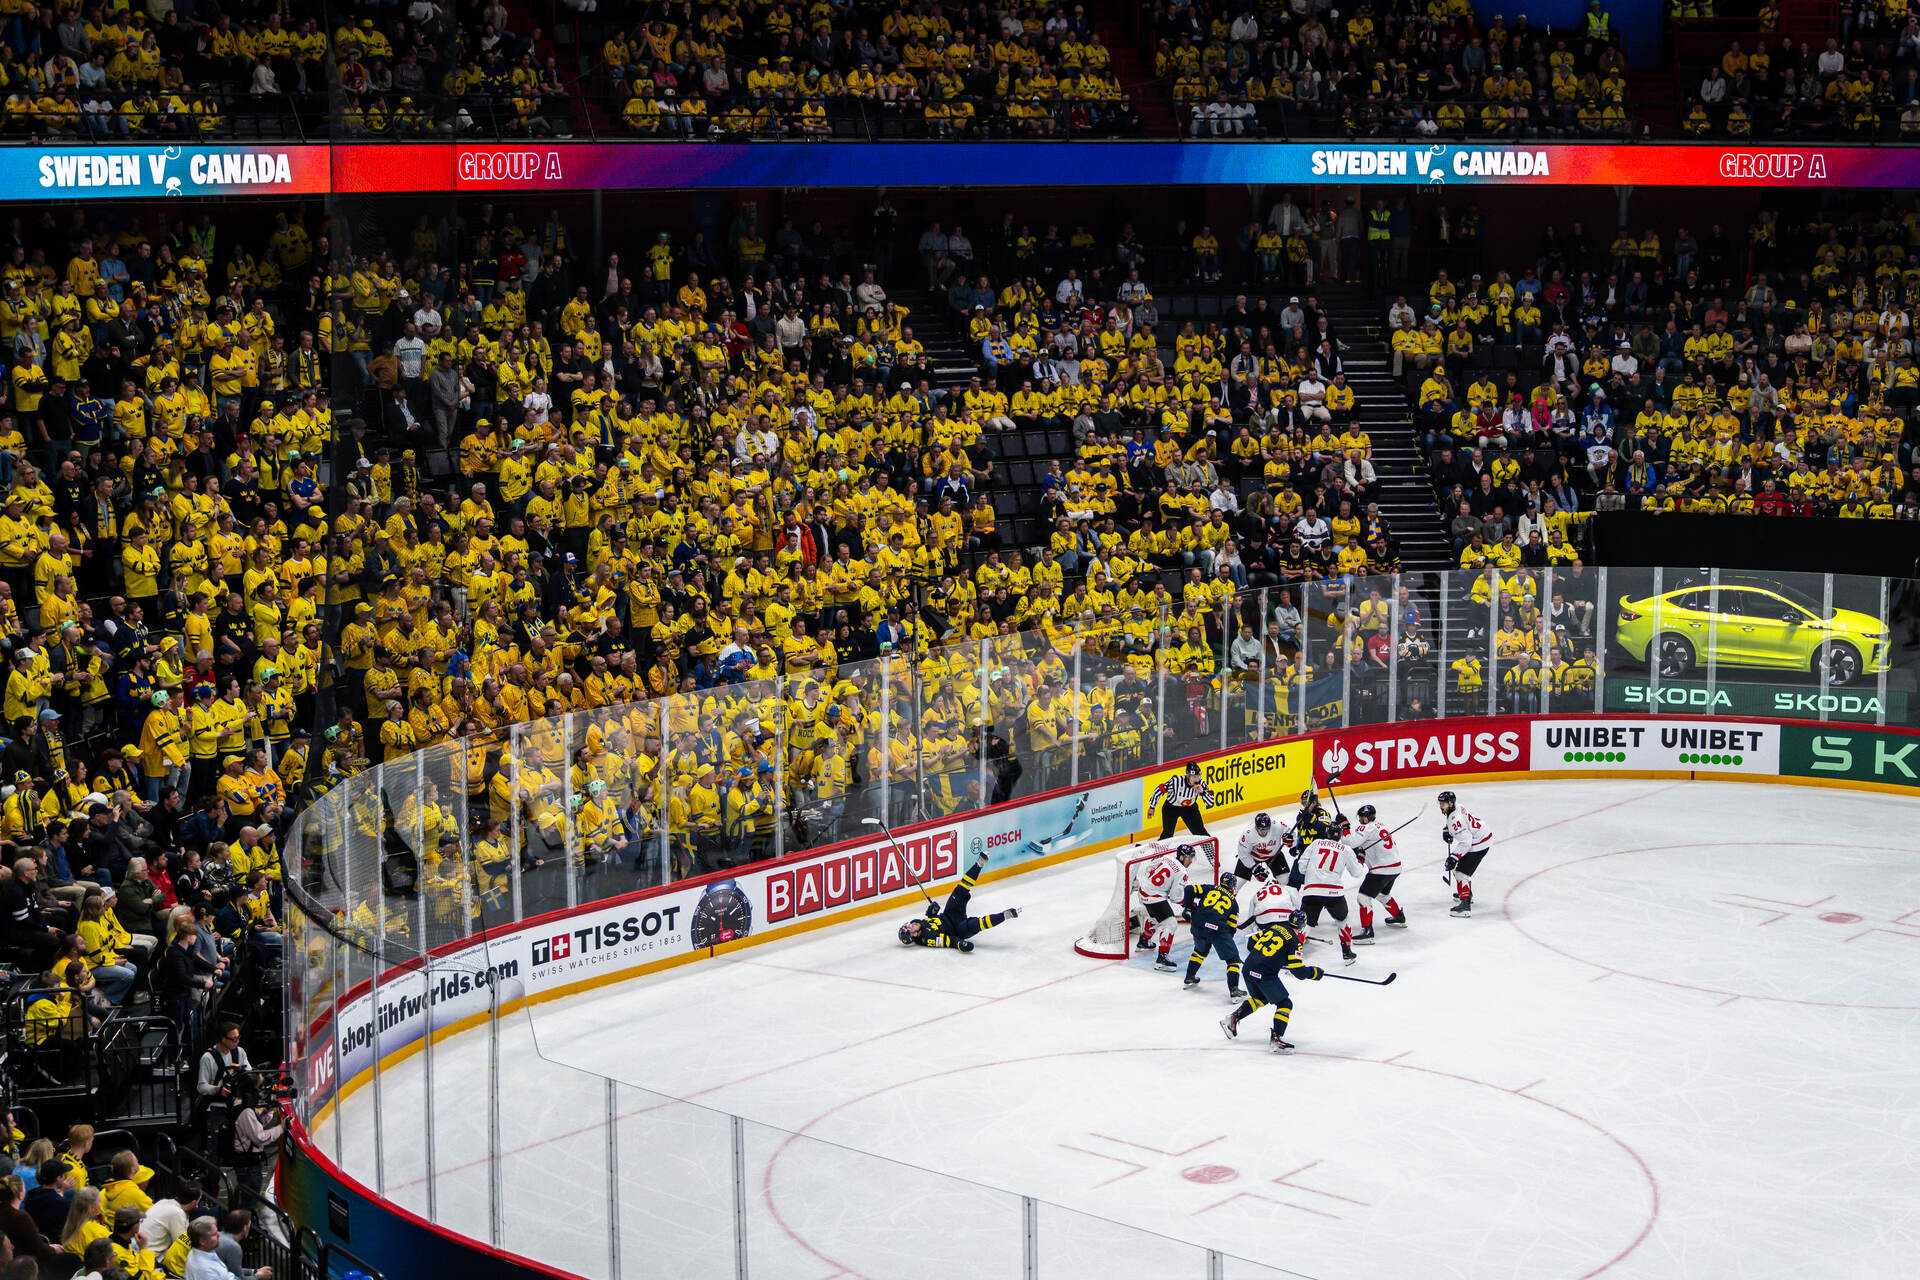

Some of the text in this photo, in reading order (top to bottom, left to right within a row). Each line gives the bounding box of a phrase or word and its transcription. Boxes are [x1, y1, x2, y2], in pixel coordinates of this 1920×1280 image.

[39, 154, 141, 187] SWEDEN
[189, 153, 292, 185] CANADA
[458, 152, 563, 181] GROUP A
[1311, 151, 1406, 176] SWEDEN
[1452, 151, 1550, 177] CANADA
[1719, 153, 1827, 179] GROUP A
[1250, 702, 1339, 728] LENHDA
[1546, 727, 1645, 748] UNIBET
[1660, 728, 1764, 752] UNIBET
[1354, 731, 1520, 773] STRAUSS
[1205, 752, 1286, 785] Raiffeisen
[1091, 802, 1118, 815] Unlimited
[1091, 807, 1138, 825] ProHygienic Aqua
[987, 828, 1022, 849] BOSCH
[1379, 829, 1396, 850] 9
[1318, 848, 1339, 872] 71
[769, 833, 956, 916] BAUHAUS
[1203, 890, 1232, 915] 82
[1256, 885, 1282, 902] 50
[574, 905, 681, 954] TISSOT
[1253, 930, 1284, 957] 23
[531, 934, 682, 981] SWISS WATCHES SINCE 1853
